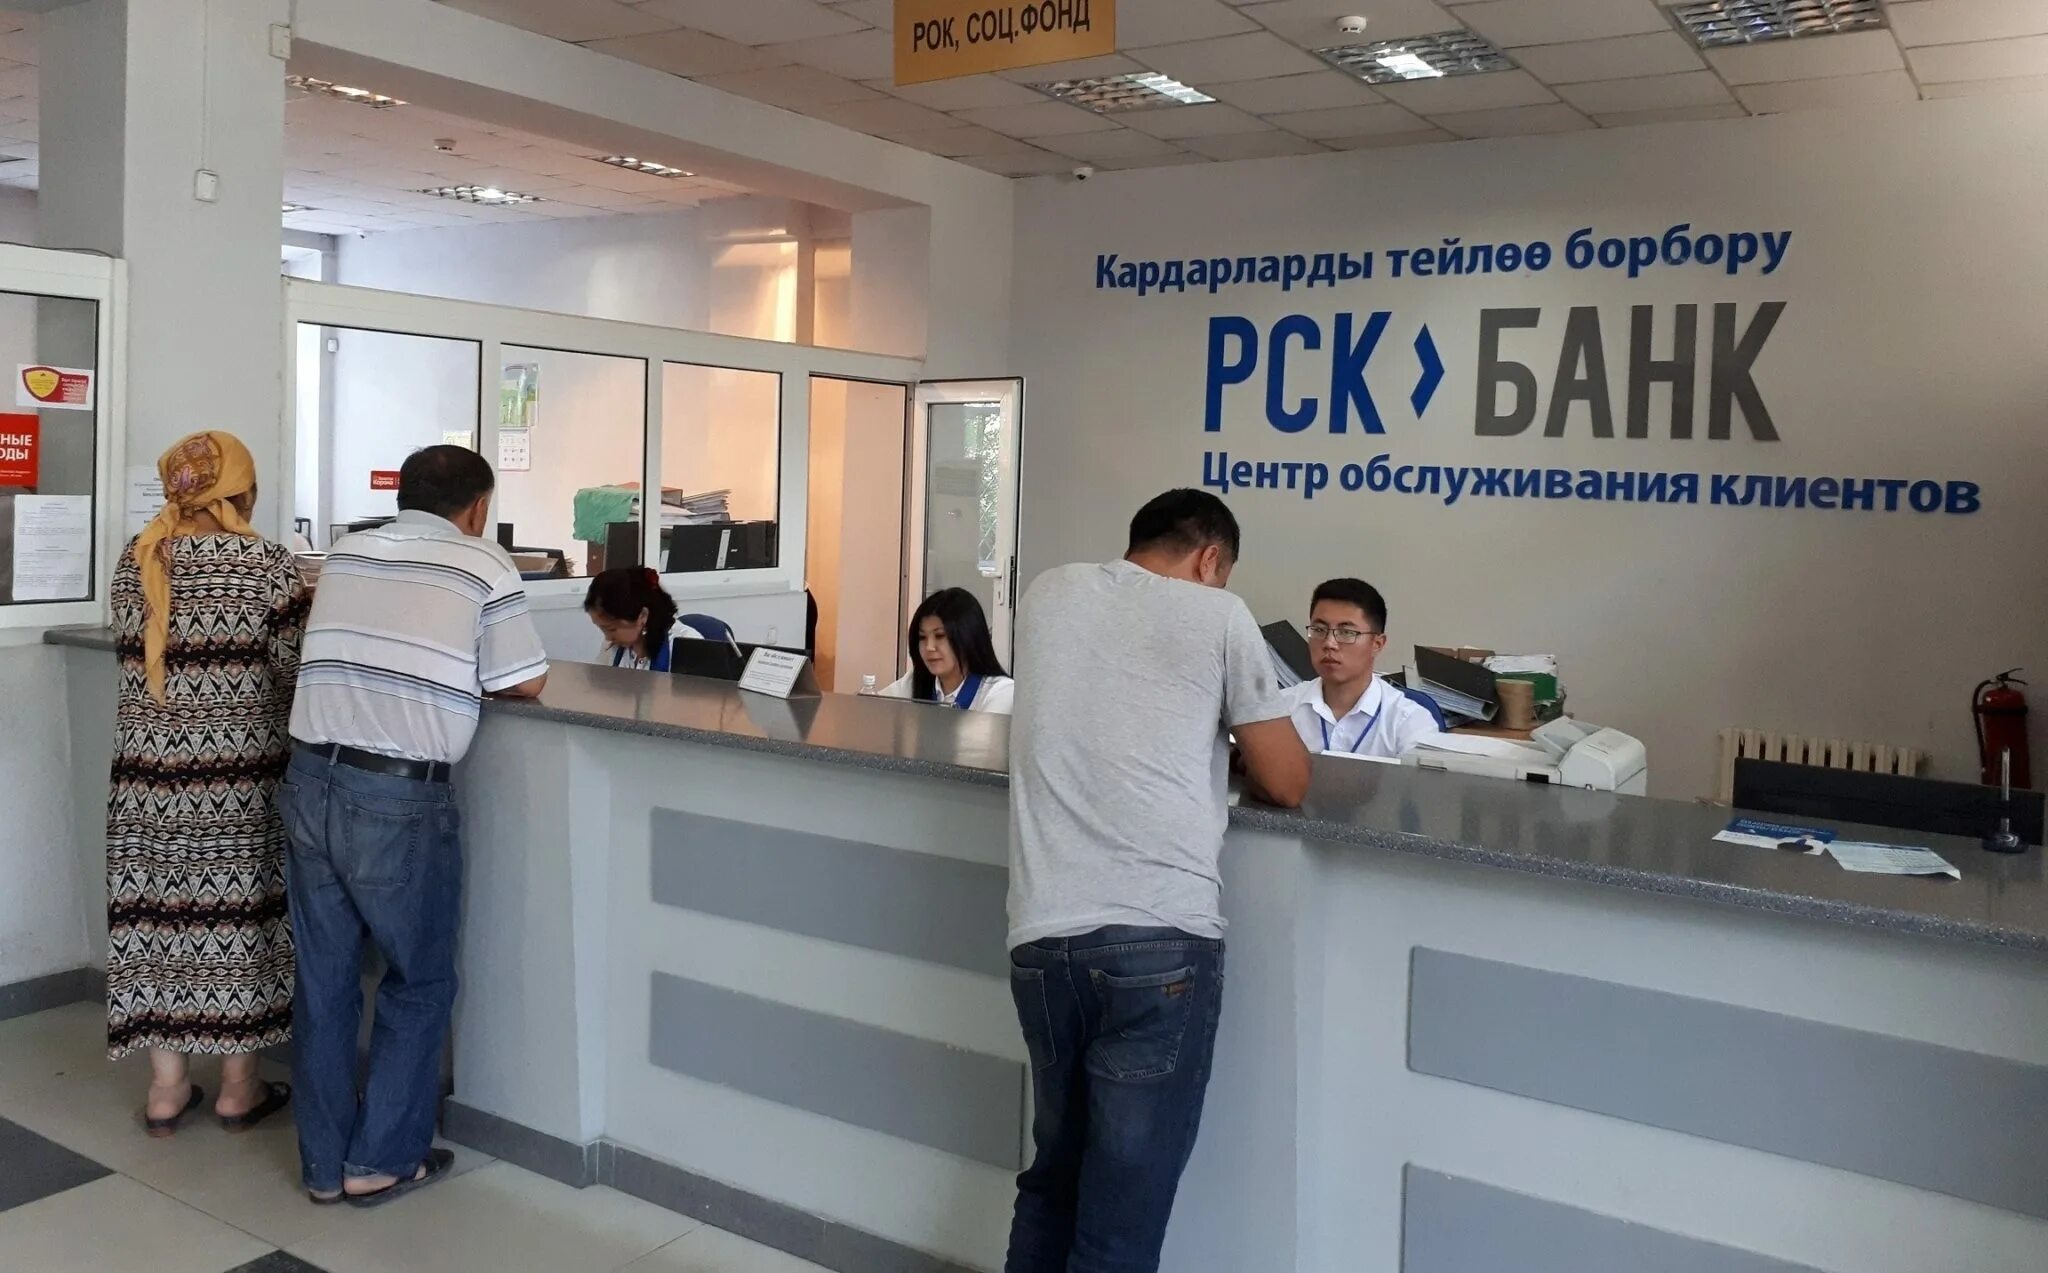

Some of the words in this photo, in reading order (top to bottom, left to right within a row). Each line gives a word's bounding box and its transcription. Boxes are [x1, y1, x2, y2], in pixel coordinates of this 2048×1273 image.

[913, 17, 959, 52] РОК,
[966, 0, 1091, 44] СОЦ.ФОНД
[1096, 250, 1373, 296] Кардарларды
[1386, 237, 1552, 278] тейлөө
[1565, 223, 1792, 278] борбору
[1204, 311, 1393, 434] РСК
[1474, 301, 1788, 442] БАНК
[1203, 451, 1329, 499] Центр
[1340, 453, 1699, 506] обслуживания
[1710, 473, 1981, 514] клиентов
